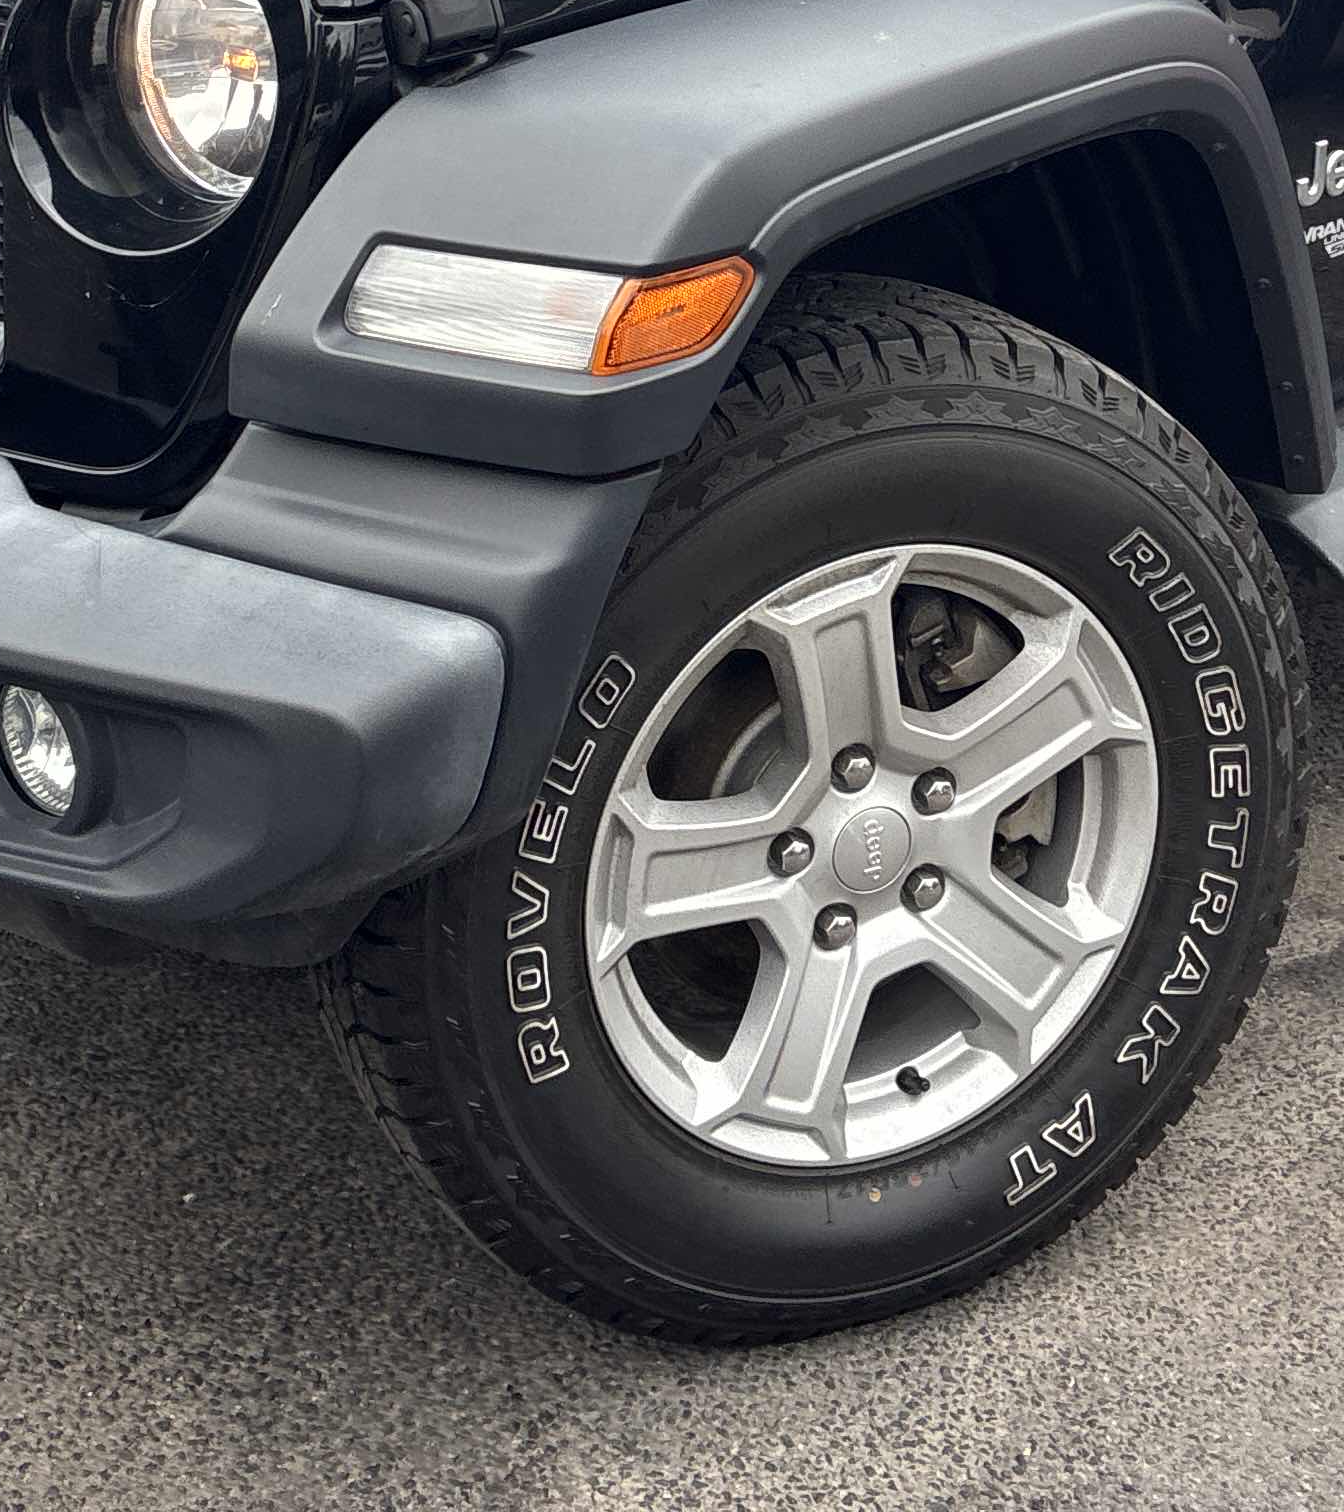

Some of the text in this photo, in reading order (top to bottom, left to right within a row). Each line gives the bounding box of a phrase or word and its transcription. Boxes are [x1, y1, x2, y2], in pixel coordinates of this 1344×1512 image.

[506, 651, 636, 1085] ROVELO
[1004, 526, 1253, 1207] RIDGETRAK AT
